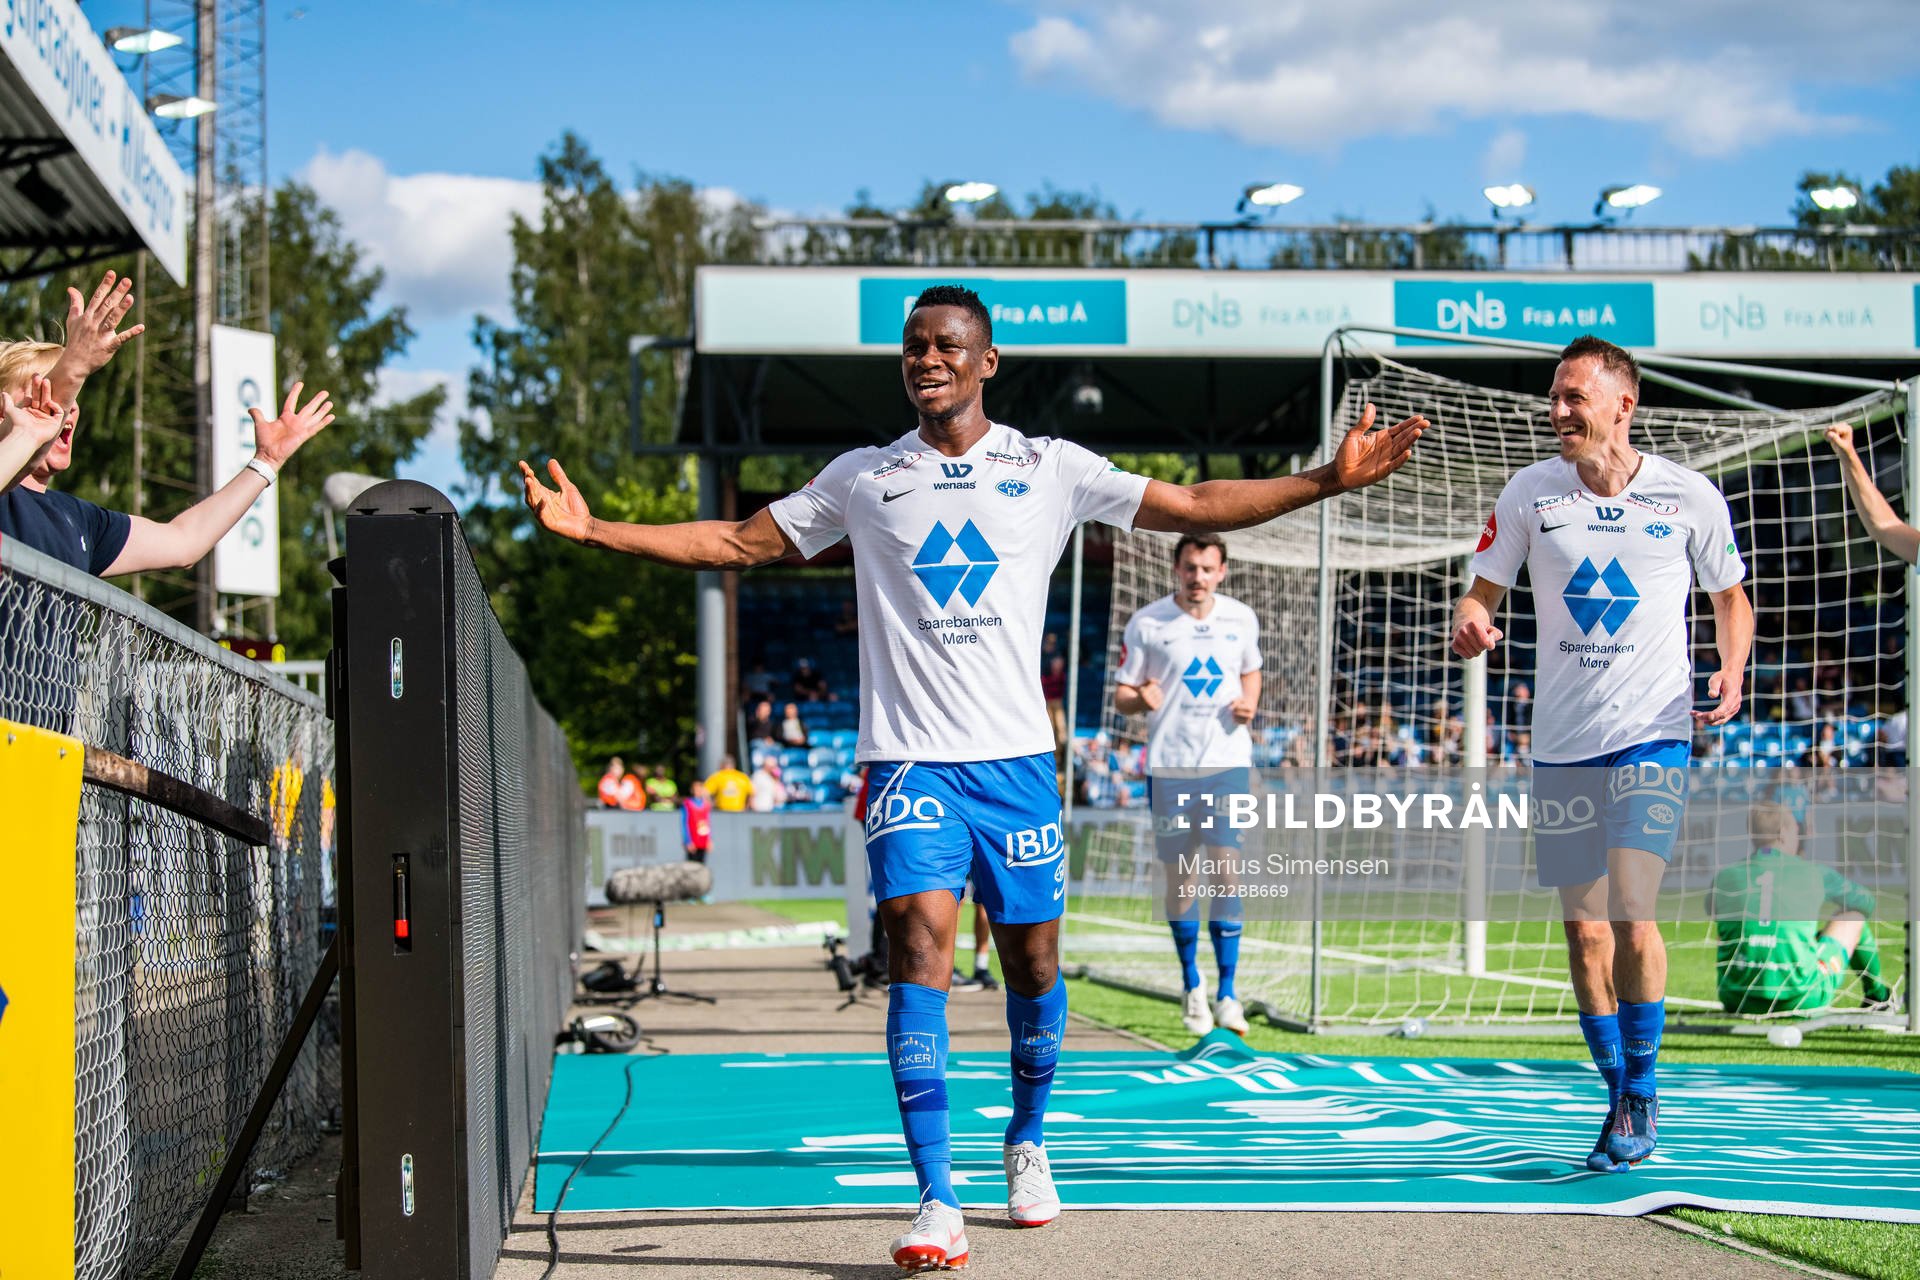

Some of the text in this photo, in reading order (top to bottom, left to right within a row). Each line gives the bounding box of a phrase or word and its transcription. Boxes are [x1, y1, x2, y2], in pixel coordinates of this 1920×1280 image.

[1173, 291, 1242, 336] DNB
[1437, 290, 1507, 336] DNB
[1523, 307, 1555, 327] Fra
[1558, 307, 1574, 326] A
[1577, 307, 1597, 327] til
[1699, 293, 1767, 338] DNB
[1818, 309, 1833, 326] A
[934, 481, 976, 490] wenaas
[1629, 492, 1662, 508] sport
[1587, 523, 1627, 533] wenaas
[918, 615, 1002, 632] Sparebanken
[942, 633, 977, 645] Møre
[1559, 641, 1634, 654] Sparebanken
[1579, 657, 1610, 669] Møre
[1617, 761, 1684, 796] BDO
[751, 827, 846, 886] KIW
[1756, 870, 1775, 926] 1
[1023, 1042, 1058, 1054] AKER
[898, 1053, 932, 1066] AKER
